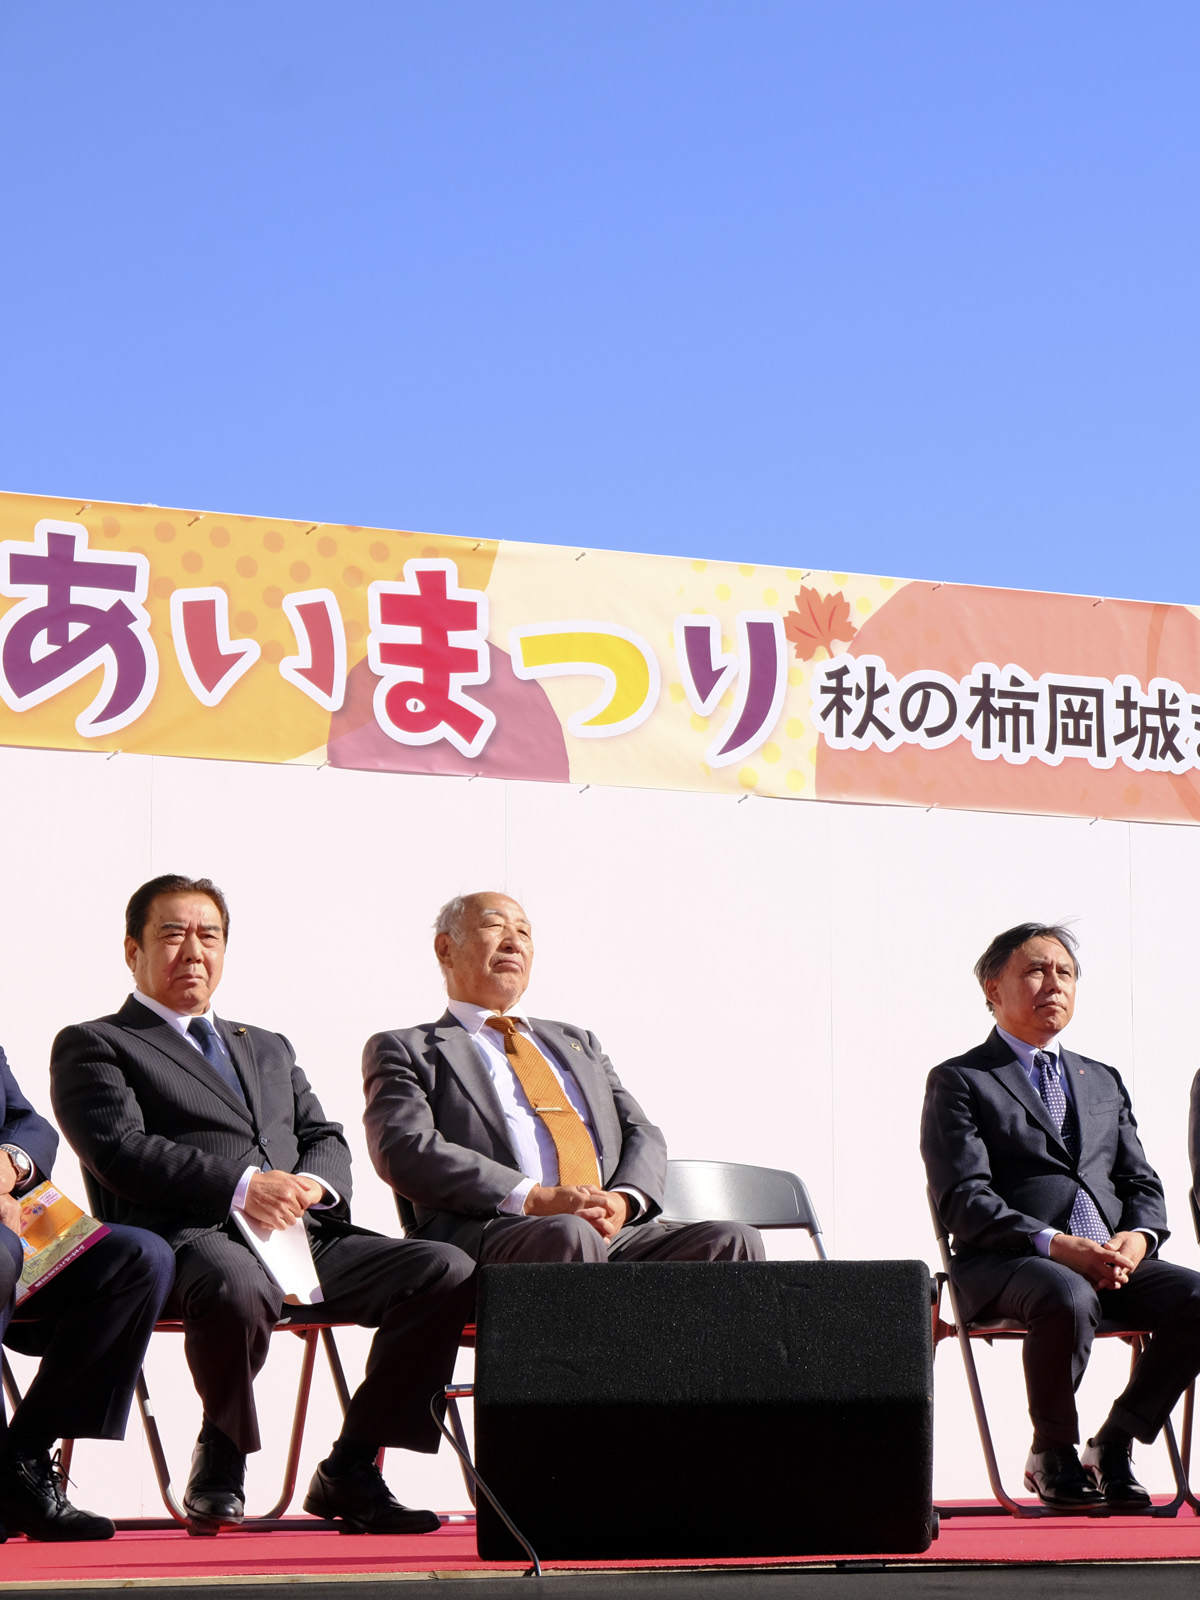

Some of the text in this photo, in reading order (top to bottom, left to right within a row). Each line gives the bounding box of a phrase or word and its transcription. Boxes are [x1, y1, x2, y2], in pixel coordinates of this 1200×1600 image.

[1, 529, 780, 759] あいまつり
